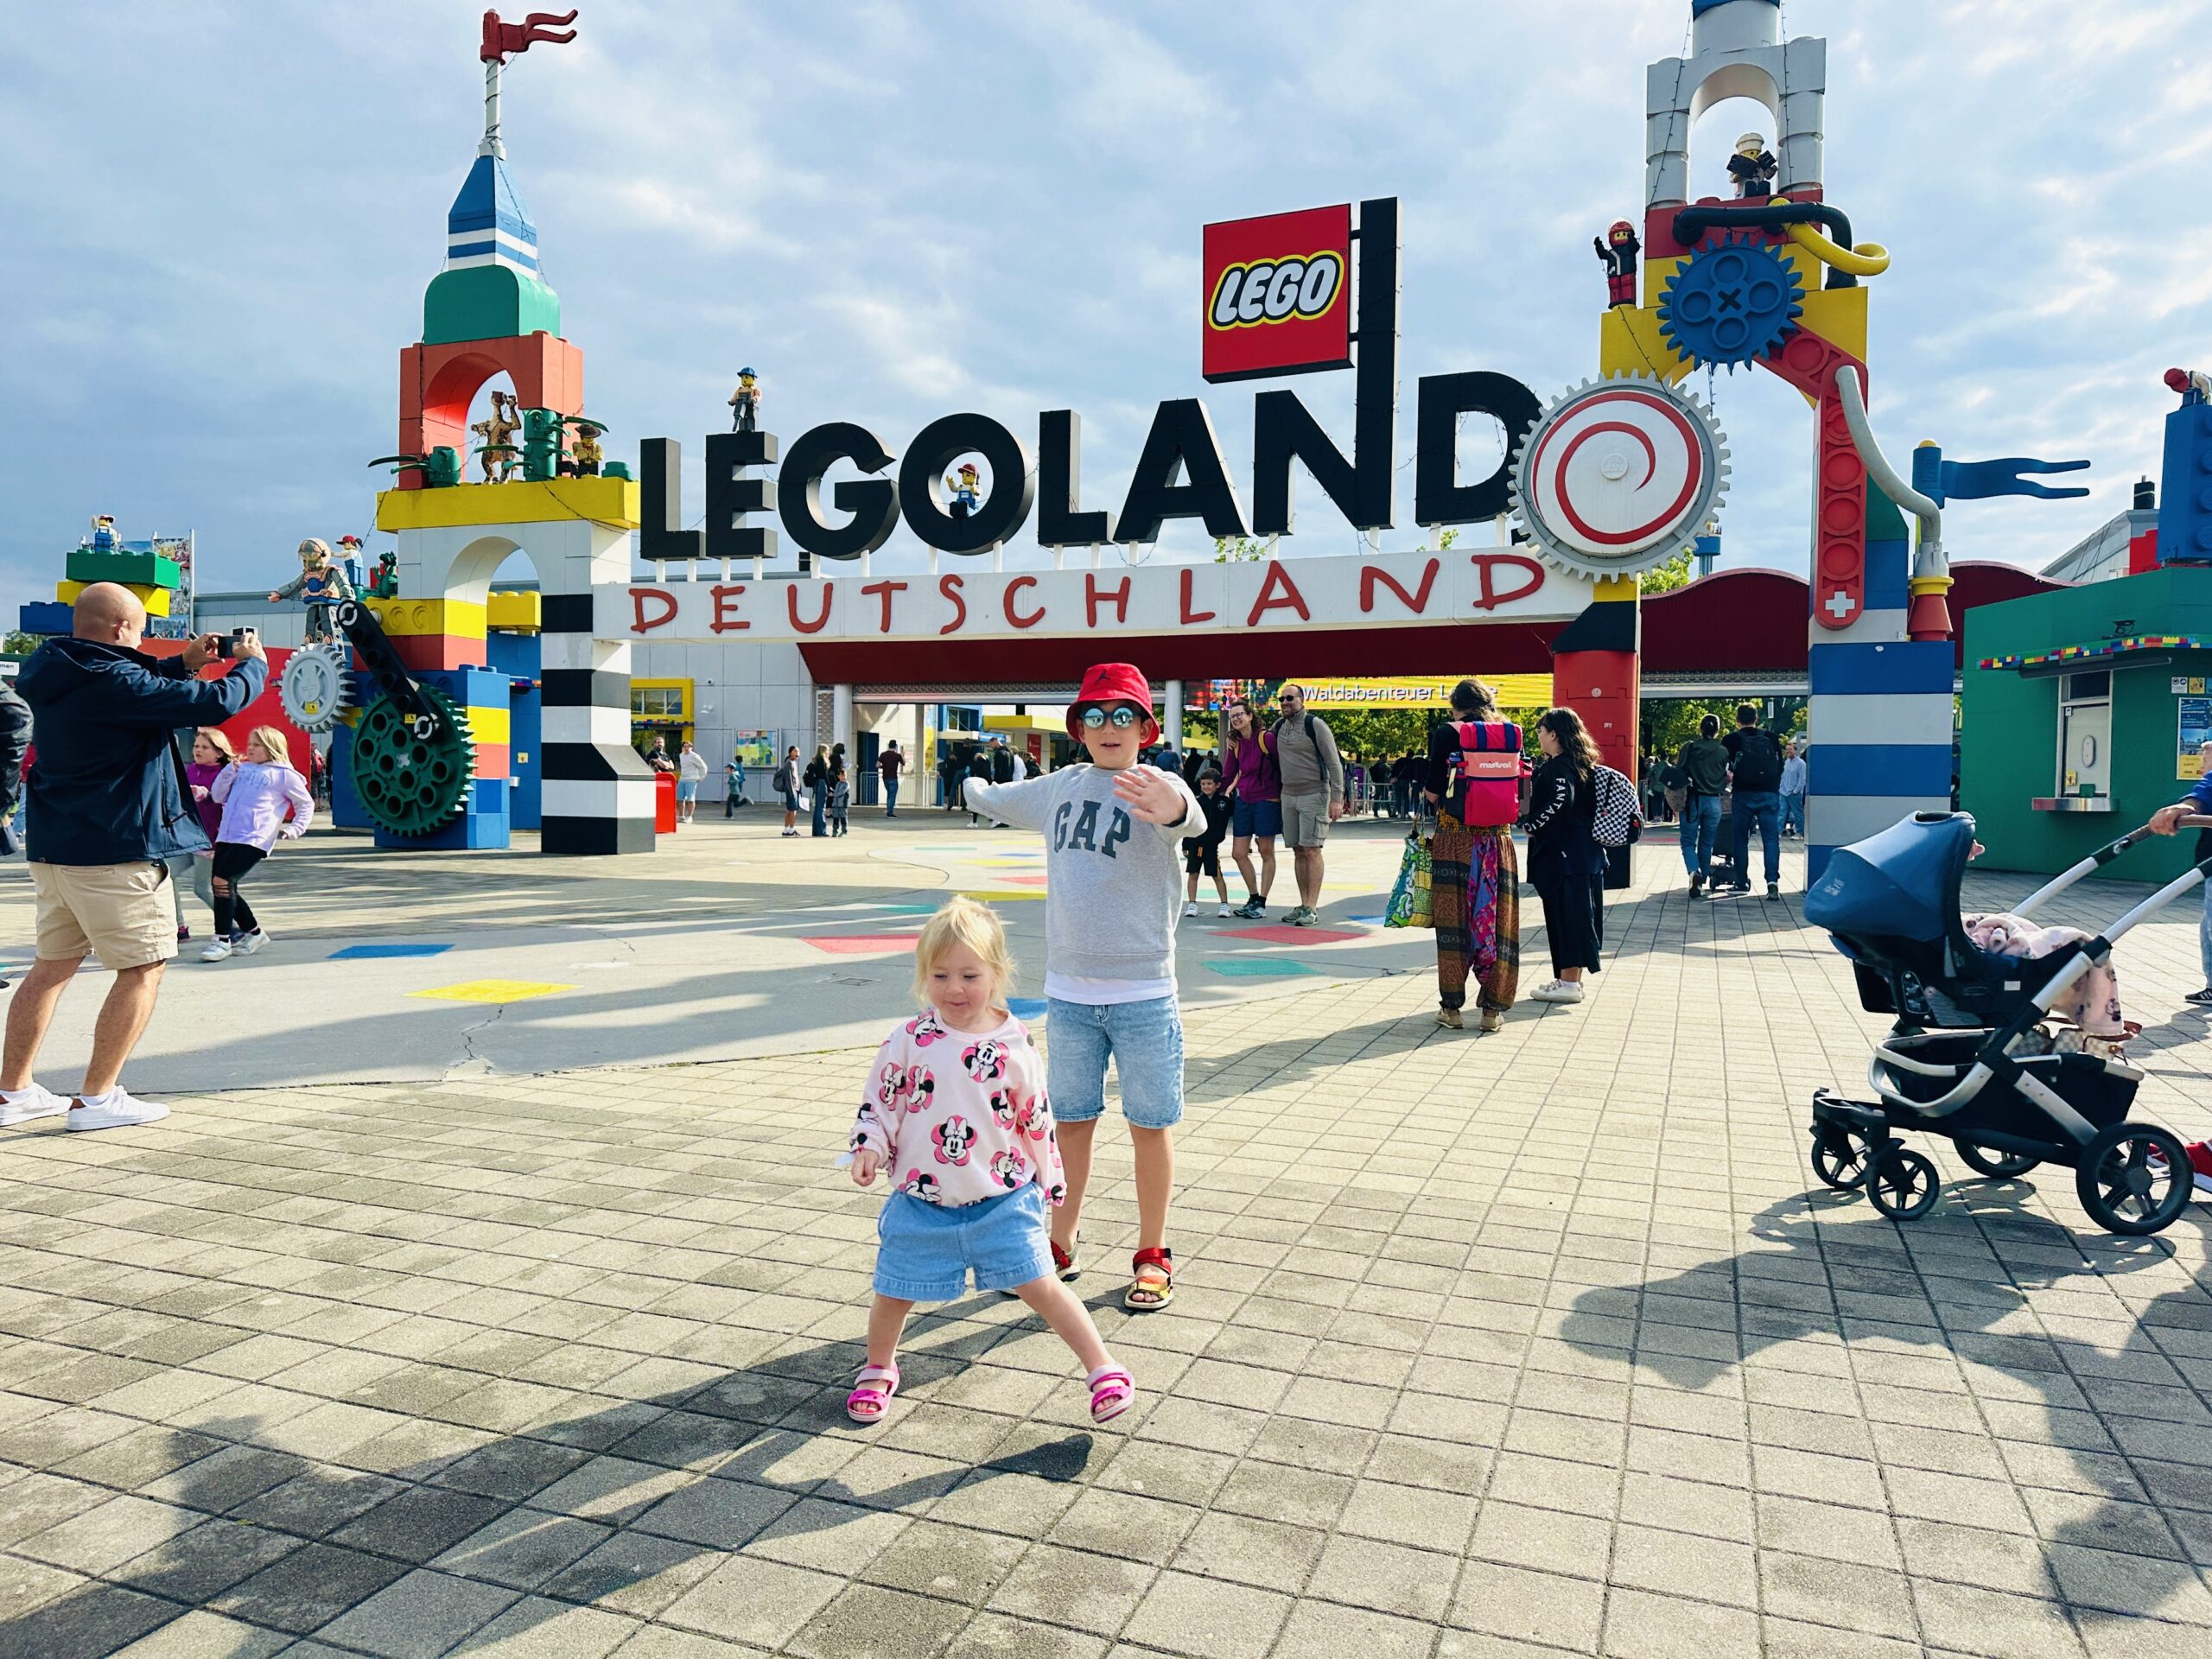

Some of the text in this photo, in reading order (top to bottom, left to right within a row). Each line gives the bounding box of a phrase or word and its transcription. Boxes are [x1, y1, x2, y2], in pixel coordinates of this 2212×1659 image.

[1211, 253, 1341, 327] LEGO
[640, 197, 1543, 561] LEGOLAND
[628, 554, 1545, 635] DEUTSCHLAND
[1303, 684, 1435, 701] Waldabenteuer
[1053, 799, 1130, 859] GAP
[1524, 778, 1566, 832] FANTASTIC
